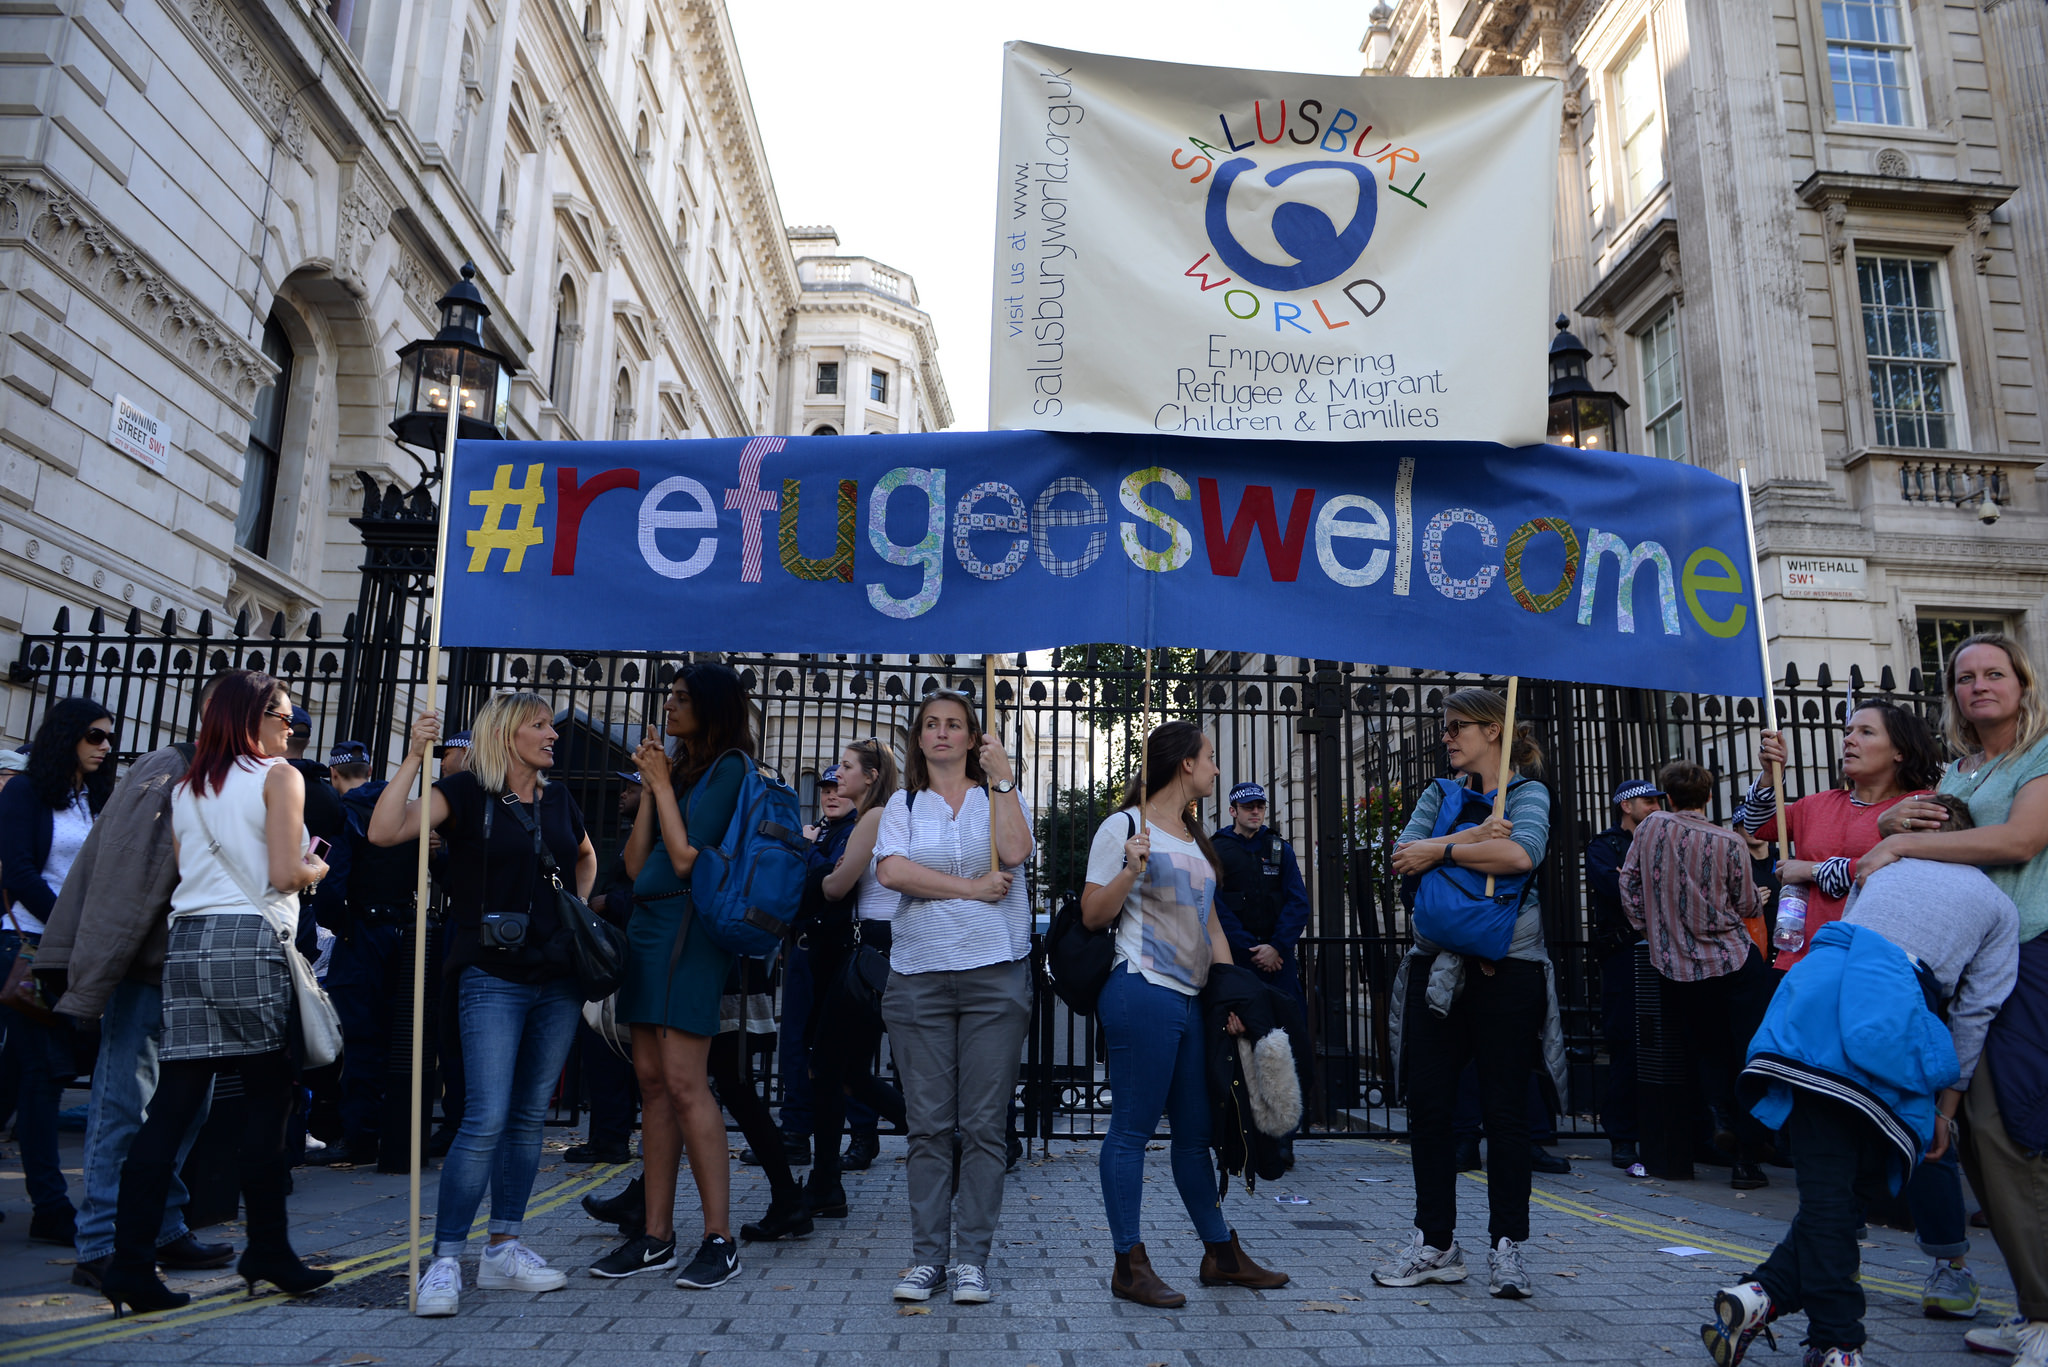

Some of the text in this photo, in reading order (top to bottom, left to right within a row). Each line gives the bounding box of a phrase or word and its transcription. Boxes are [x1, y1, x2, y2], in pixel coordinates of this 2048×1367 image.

[1171, 99, 1428, 208] SALUSBURY
[1003, 162, 1029, 338] visit us at www.
[1027, 67, 1085, 418] salusburyworld.org.uk
[1184, 252, 1386, 334] WORLD
[1208, 334, 1396, 381] Empowering
[1176, 367, 1448, 412] Refugee & Migrant
[117, 417, 165, 457] STREET SW1
[120, 401, 157, 435] DOWNING
[1154, 399, 1439, 432] Children & Families
[466, 436, 1748, 638] #refugeeswelcome
[1787, 560, 1859, 573] WHITEHALL
[1789, 573, 1814, 584] SW1
